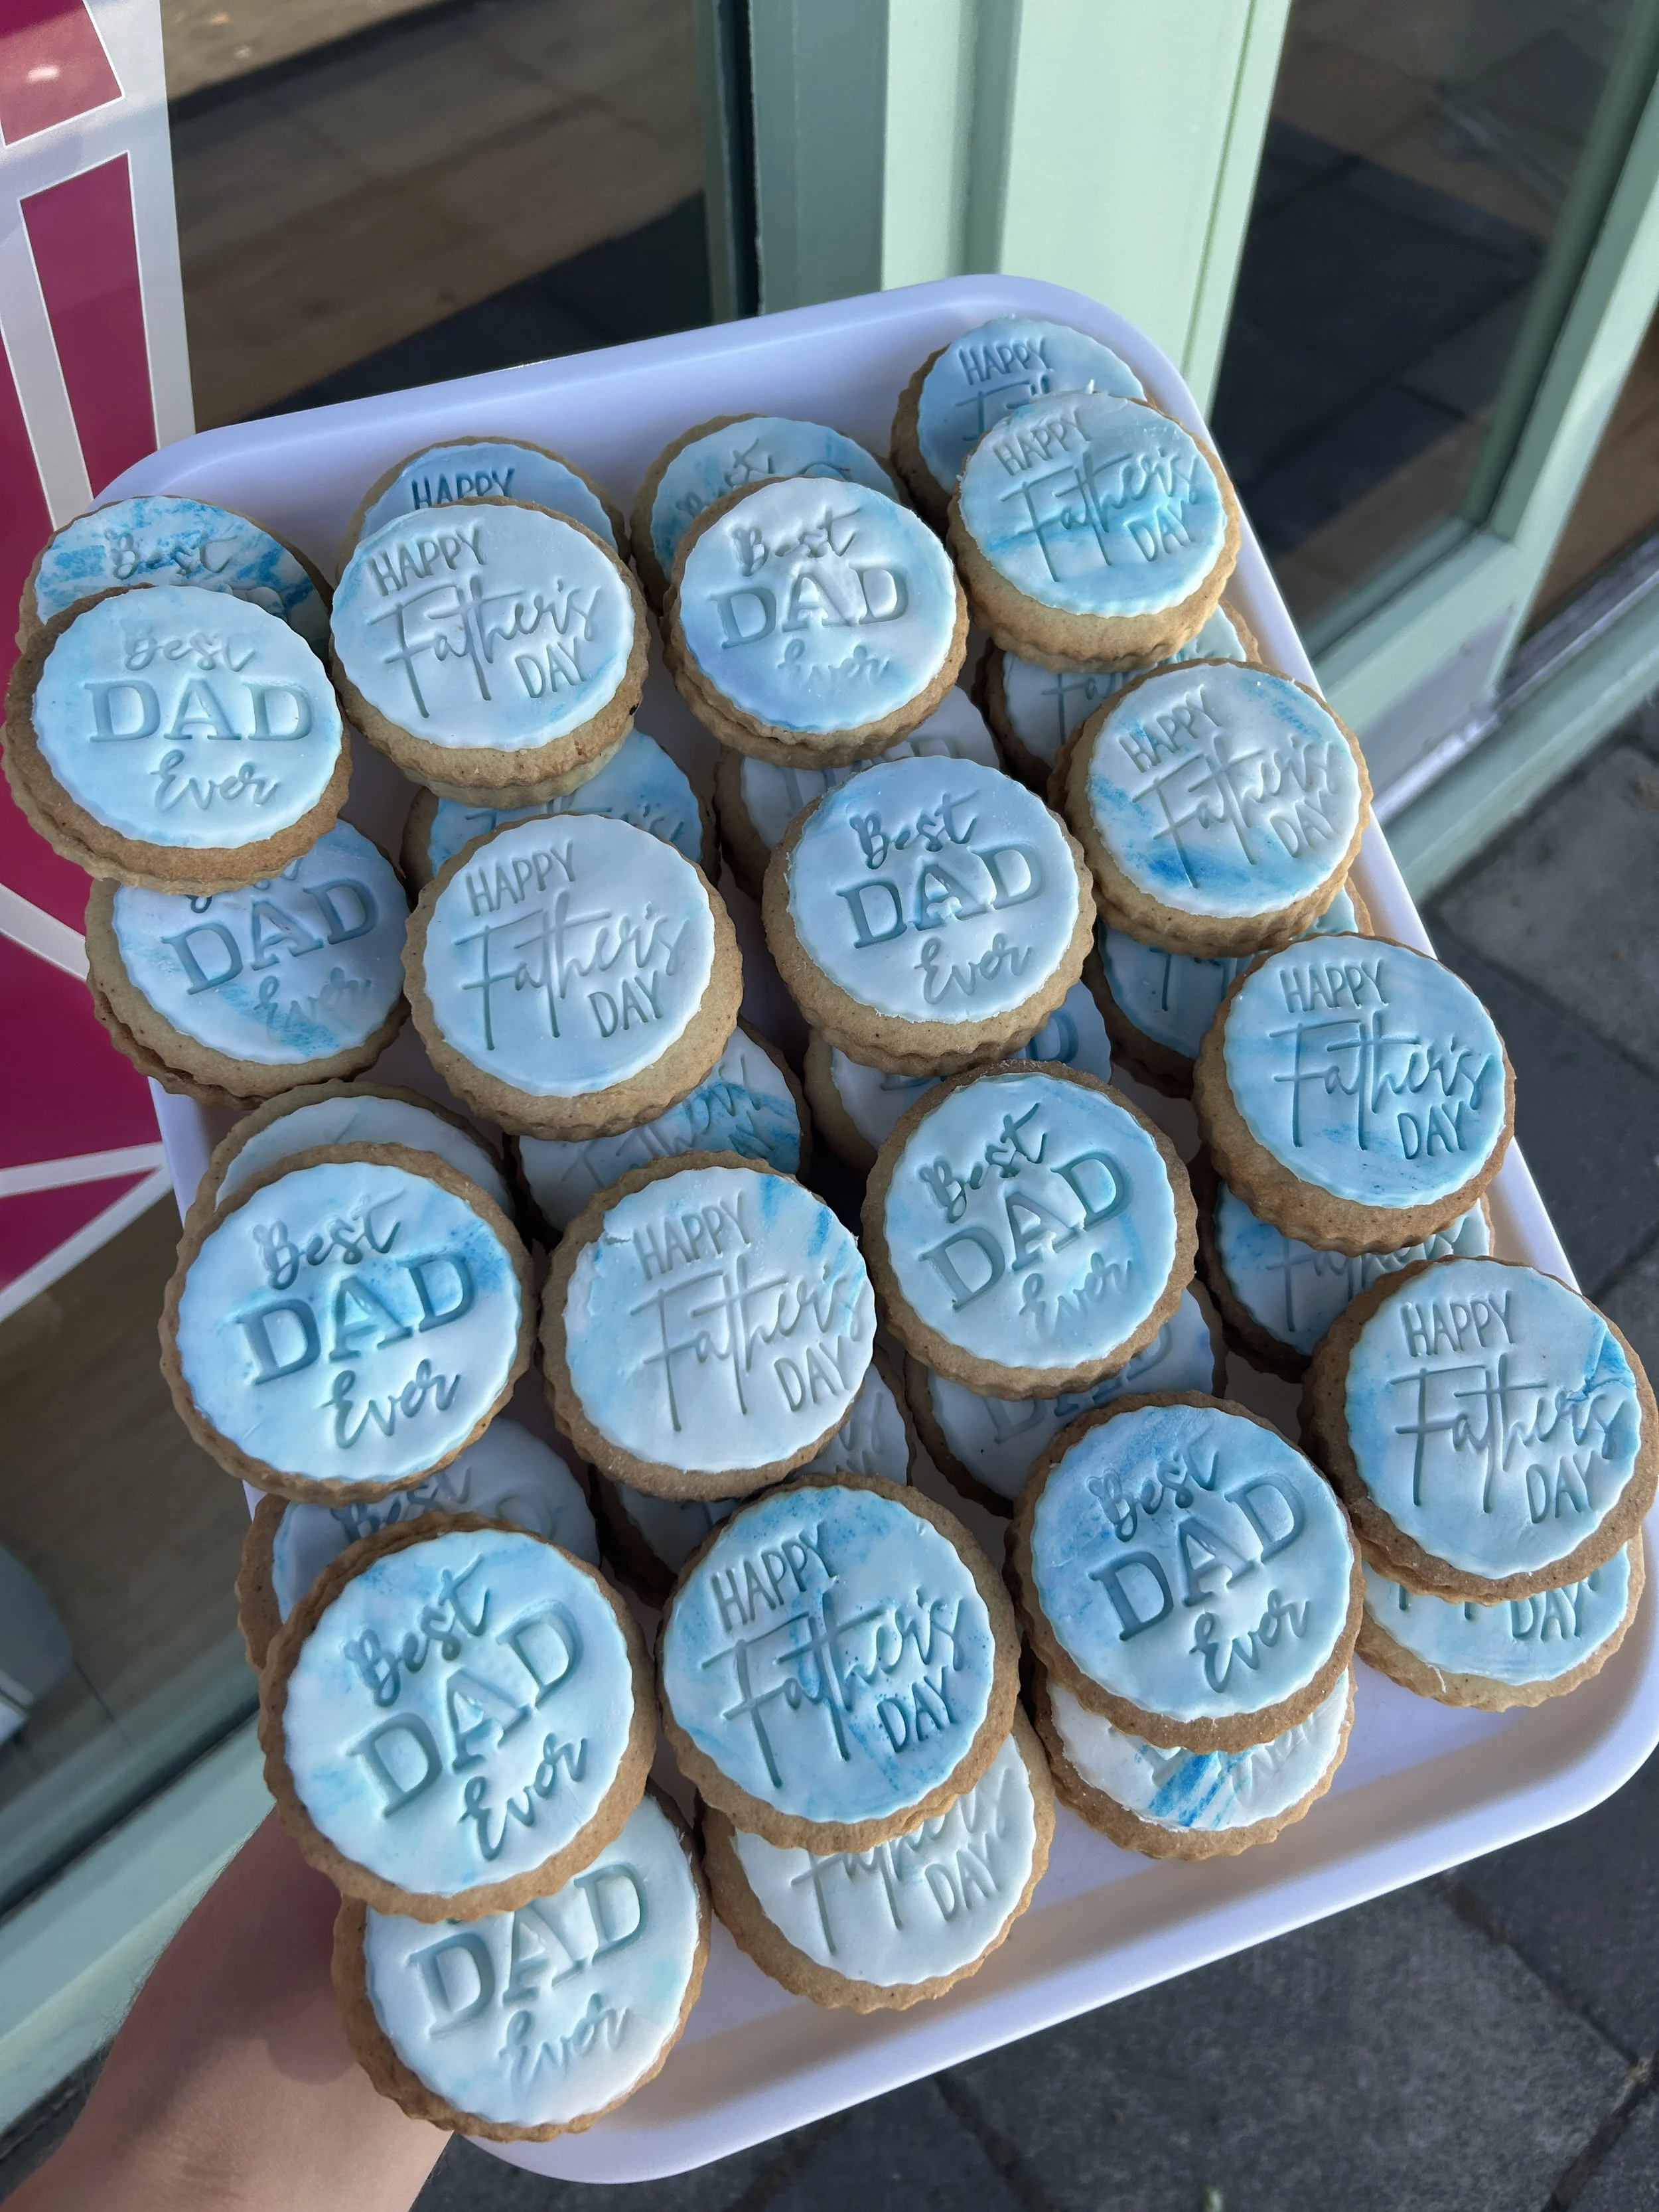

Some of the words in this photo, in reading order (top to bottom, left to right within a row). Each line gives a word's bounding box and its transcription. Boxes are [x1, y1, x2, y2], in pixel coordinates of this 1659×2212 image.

[959, 337, 1047, 386] HAPPY
[994, 406, 1092, 476] HAPPY
[411, 468, 515, 510] HAPPY
[1000, 447, 1200, 583] Father's
[1125, 498, 1196, 562] DAY
[368, 526, 486, 596] HAPPY
[733, 505, 861, 577] Best
[119, 616, 256, 672] Best
[367, 575, 601, 718] Father's
[708, 562, 908, 649] DAD
[84, 678, 313, 742] DAD
[515, 636, 585, 698] DAY
[1119, 684, 1223, 773] HAPPY
[150, 749, 278, 812] Ever
[1132, 734, 1337, 889] Father's
[1269, 790, 1338, 858] DAY
[850, 790, 979, 869] Best
[467, 840, 575, 915] HAPPY
[837, 843, 1047, 948] DAD
[161, 879, 378, 995] DAD
[456, 890, 689, 1050] Father's
[914, 933, 1032, 1003] Ever
[588, 971, 662, 1037] DAY
[1279, 960, 1389, 1012] HAPPY
[1269, 1009, 1496, 1151] Father's
[918, 1104, 1046, 1222] Best
[1397, 1102, 1467, 1160] DAY
[253, 1189, 405, 1290] Best
[633, 1191, 751, 1280] HAPPY
[920, 1149, 1132, 1313] DAD
[236, 1254, 474, 1384] DAD
[630, 1254, 866, 1431] Father's
[1402, 1290, 1514, 1356] HAPPY
[319, 1359, 461, 1449] Ever
[775, 1335, 849, 1412] DAY
[1086, 1425, 1218, 1542] Best
[1526, 1449, 1592, 1522] DAY
[711, 1521, 837, 1632] HAPPY
[1090, 1470, 1306, 1642] DAD
[345, 1555, 489, 1706] Best
[1190, 1589, 1310, 1692] Ever
[346, 1601, 582, 1817] DAD
[701, 1585, 964, 1789] Father's
[877, 1666, 955, 1753] DAY
[459, 1733, 587, 1860] Ever
[925, 1833, 1001, 1921] DAY
[407, 1863, 647, 2040] DAD
